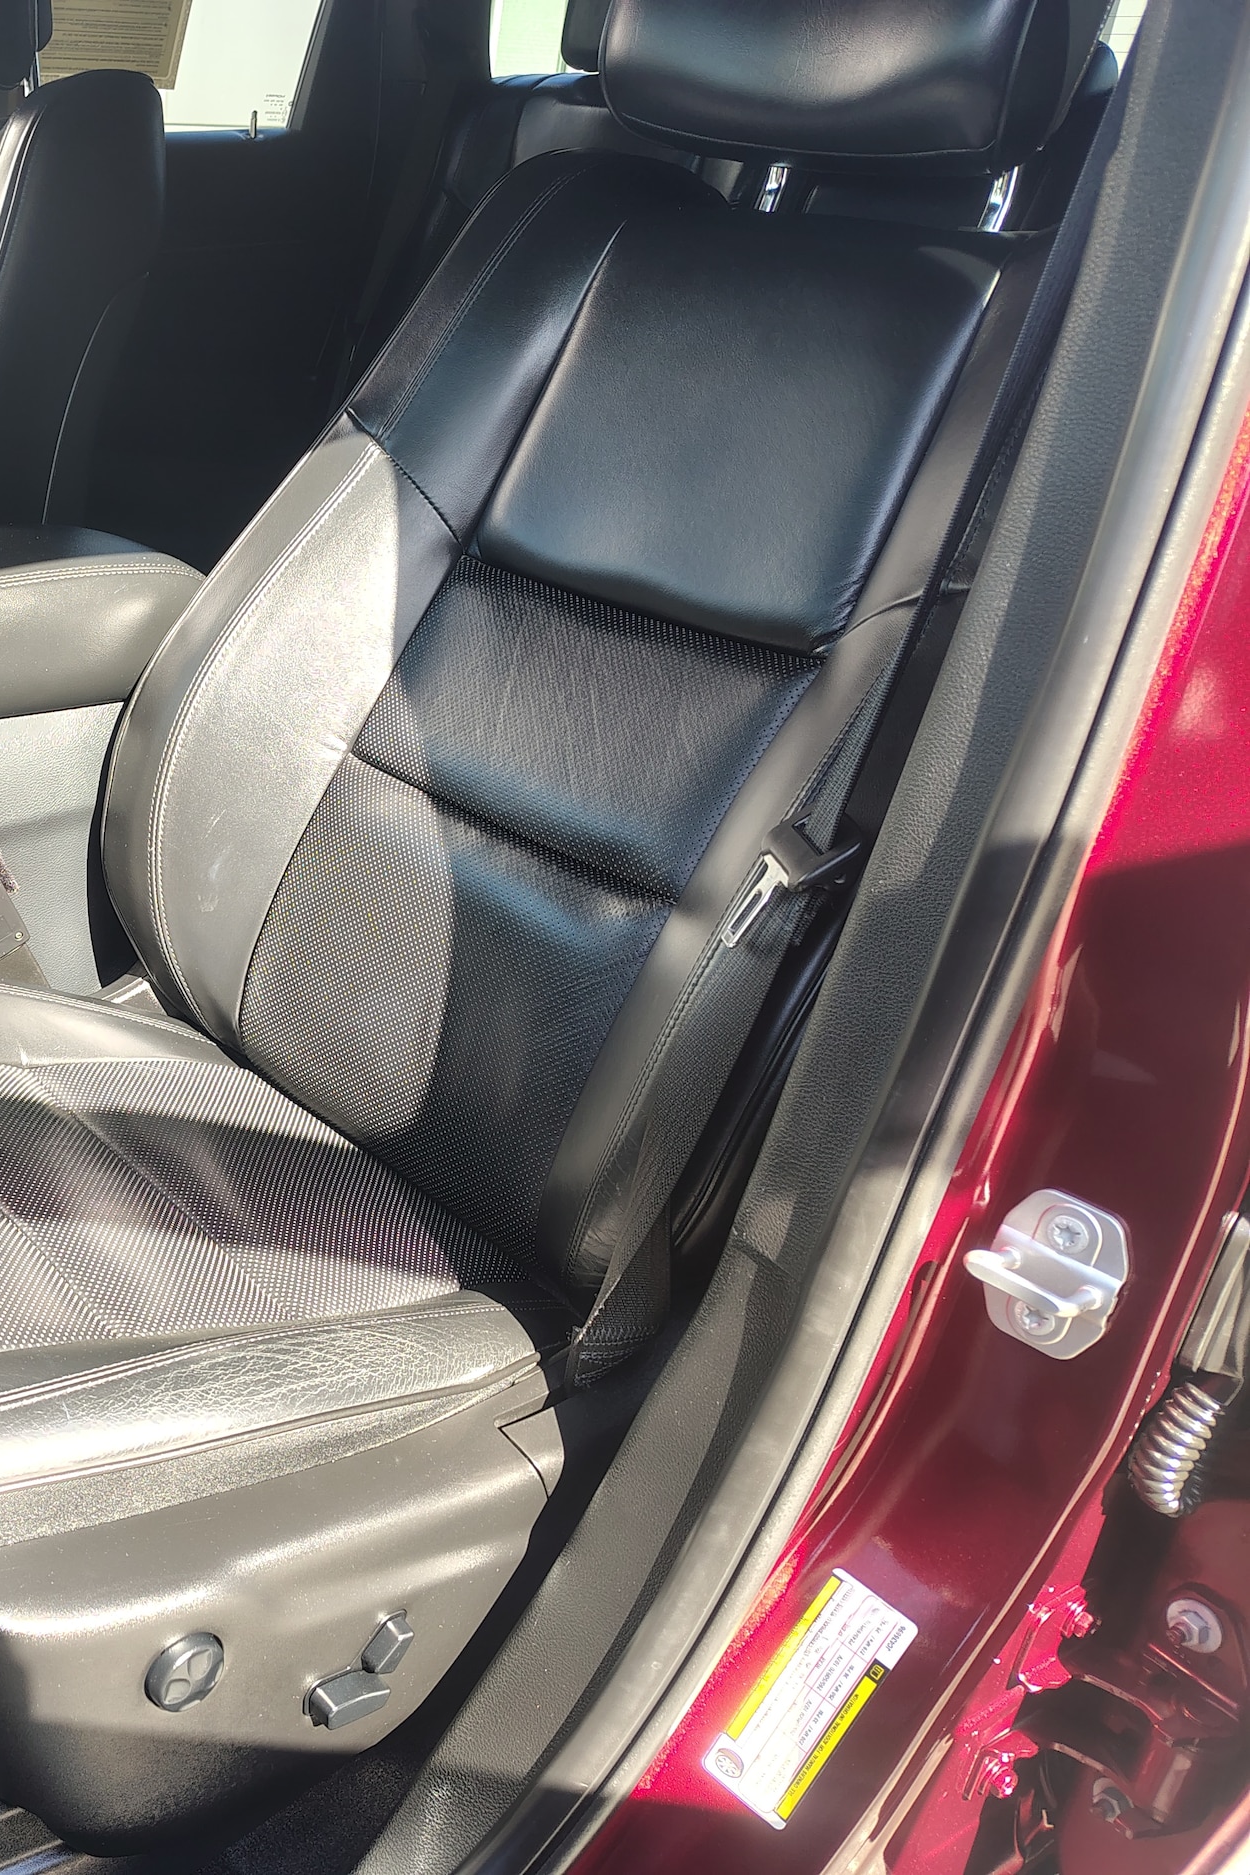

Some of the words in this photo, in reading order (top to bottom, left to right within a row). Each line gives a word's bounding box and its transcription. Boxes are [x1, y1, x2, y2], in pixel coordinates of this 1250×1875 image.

[805, 1754, 818, 1771] MANUAL
[823, 1722, 841, 1745] ADDITIONAL
[839, 1694, 859, 1721] INFORMATION
